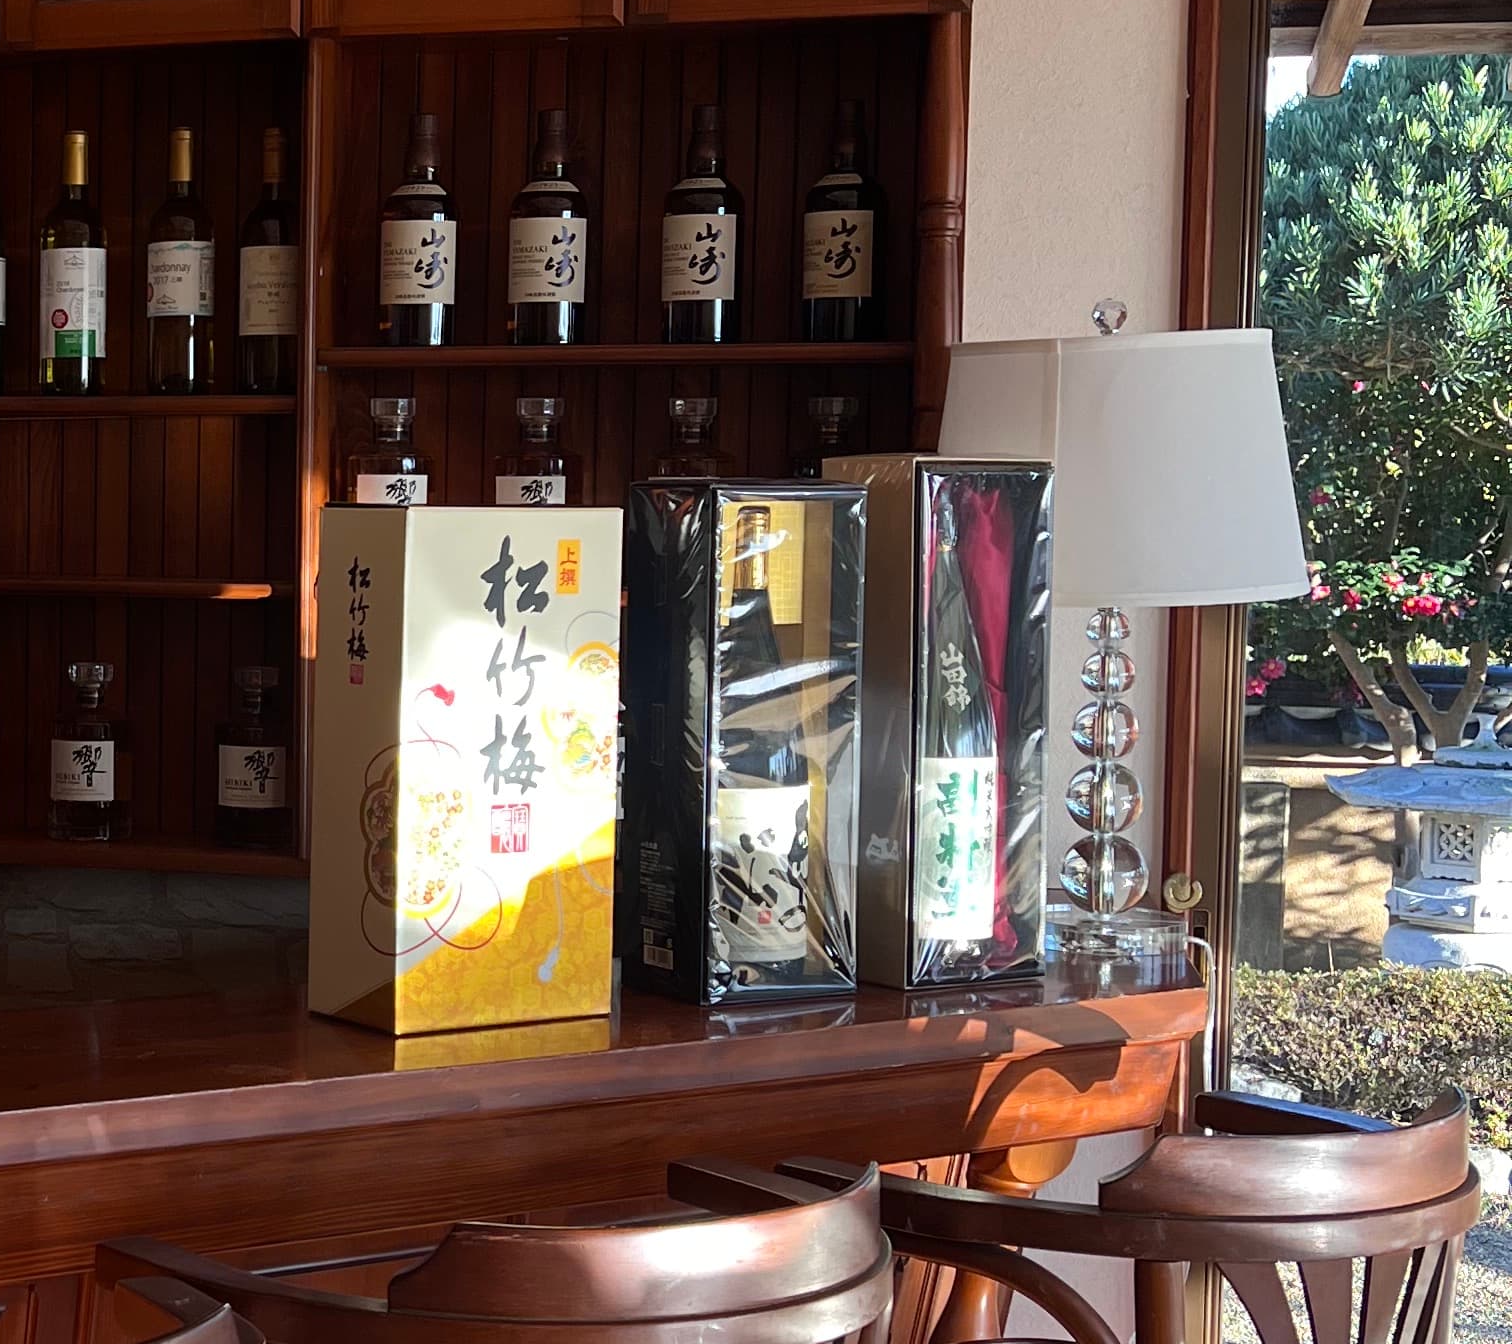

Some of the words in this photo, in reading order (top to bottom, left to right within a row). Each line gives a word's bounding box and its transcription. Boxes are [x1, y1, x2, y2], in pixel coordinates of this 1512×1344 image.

[347, 557, 370, 662] 松竹梅
[479, 535, 550, 796] 松竹梅
